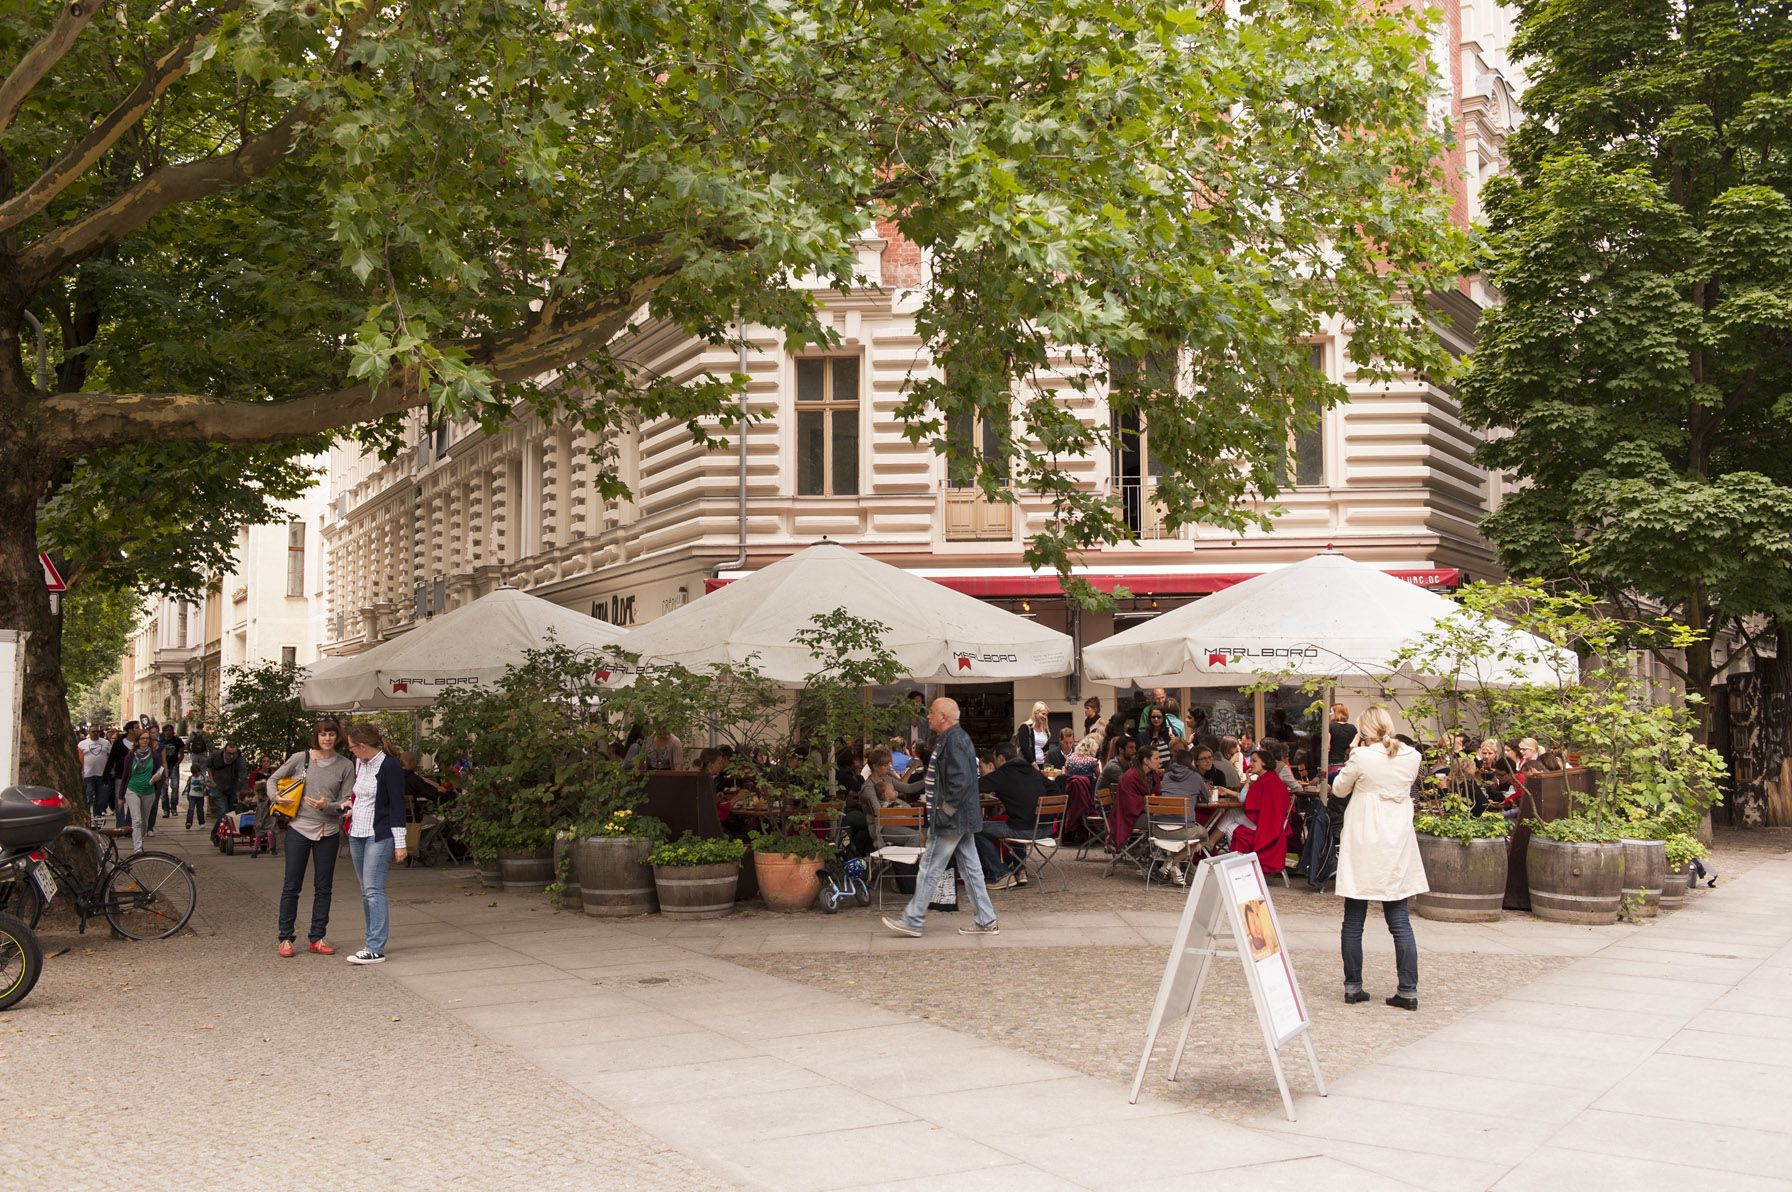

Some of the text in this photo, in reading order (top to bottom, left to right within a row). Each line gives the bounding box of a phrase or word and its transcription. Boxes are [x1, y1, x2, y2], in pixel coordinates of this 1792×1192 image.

[953, 651, 1018, 662] MARLBORO
[1204, 647, 1318, 657] MARLBORO
[389, 676, 479, 686] MARLBORO
